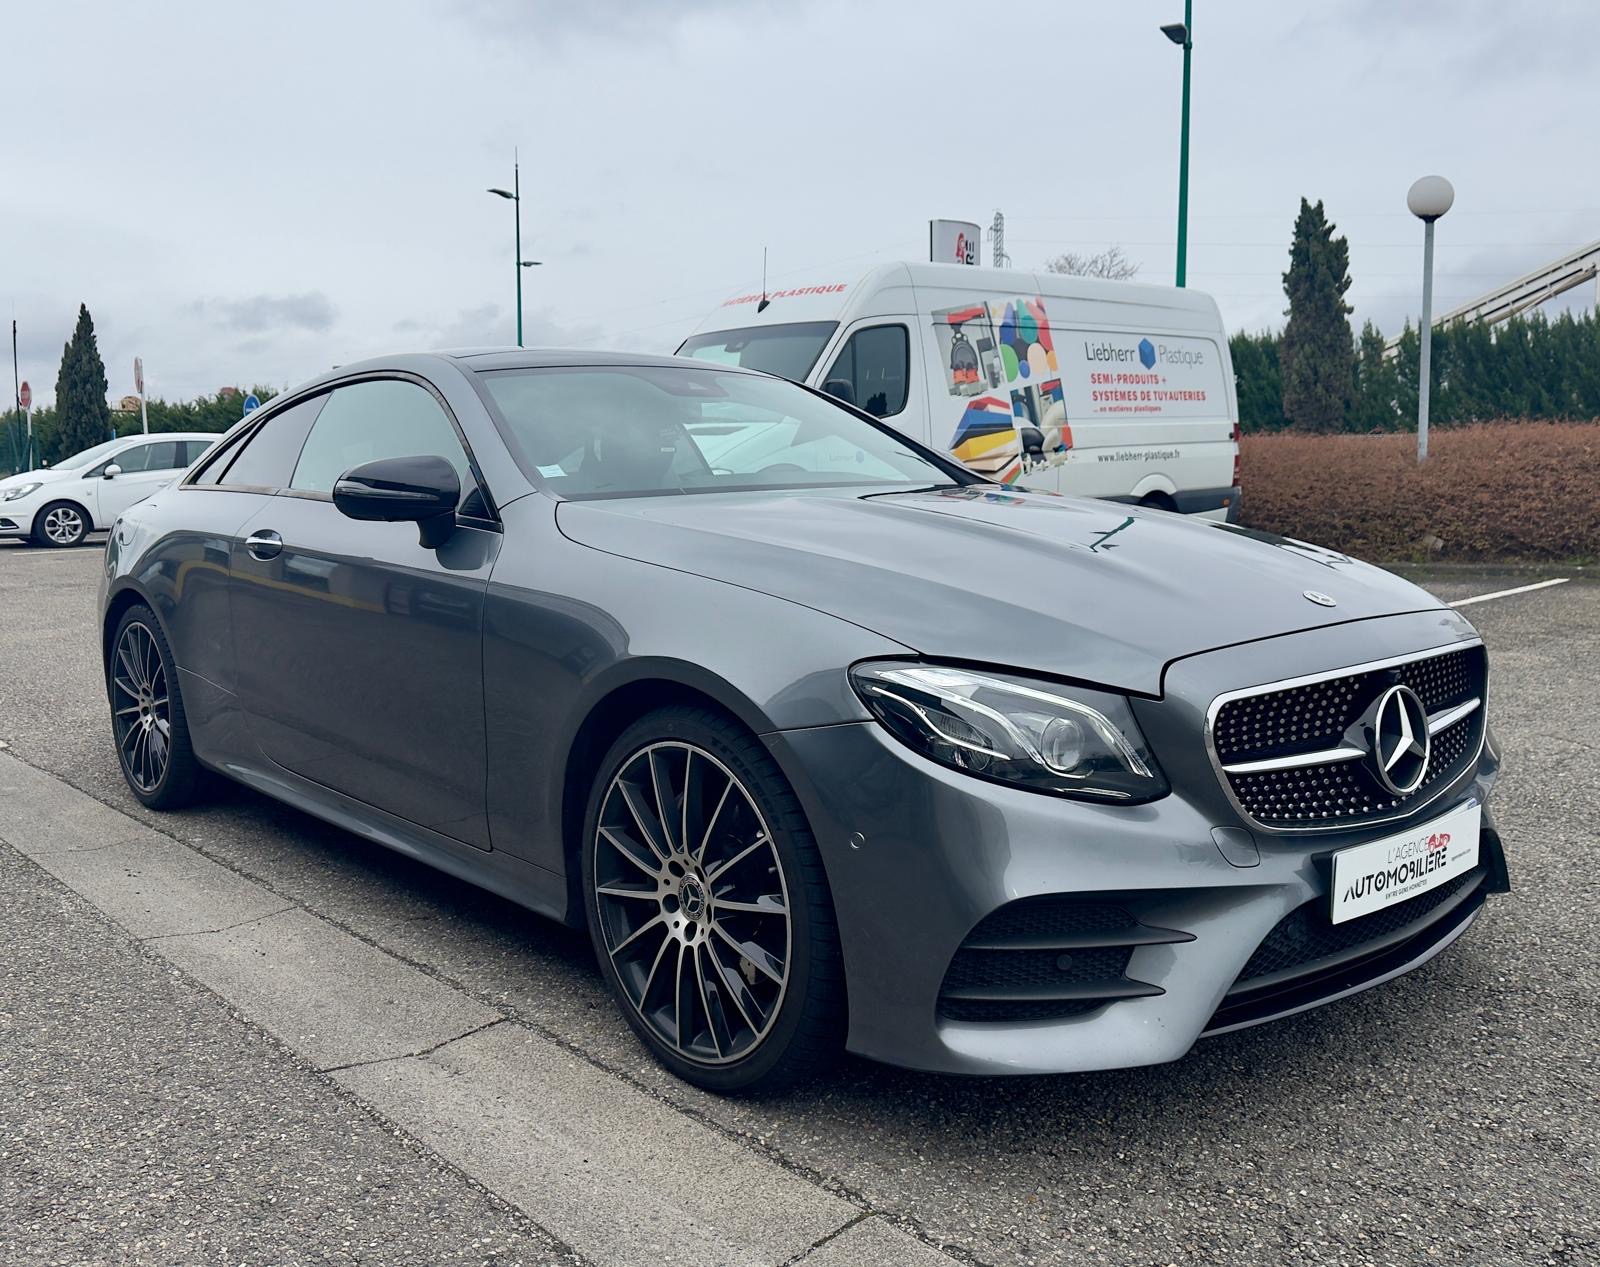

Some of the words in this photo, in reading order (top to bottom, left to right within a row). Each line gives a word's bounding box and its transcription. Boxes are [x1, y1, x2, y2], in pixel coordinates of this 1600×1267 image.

[771, 284, 848, 299] PLASTIQUE
[1085, 341, 1135, 362] Liebherr
[1158, 344, 1204, 369] Plastique
[1090, 373, 1160, 385] SEMI-PRODUITS
[1092, 387, 1138, 401] SYSTÈMES
[1140, 390, 1151, 401] DE
[1153, 390, 1206, 401] TUYAUTERIES
[1097, 449, 1180, 463] www.liebherr-plastique.fr
[1387, 835, 1429, 864] L'AGENCE
